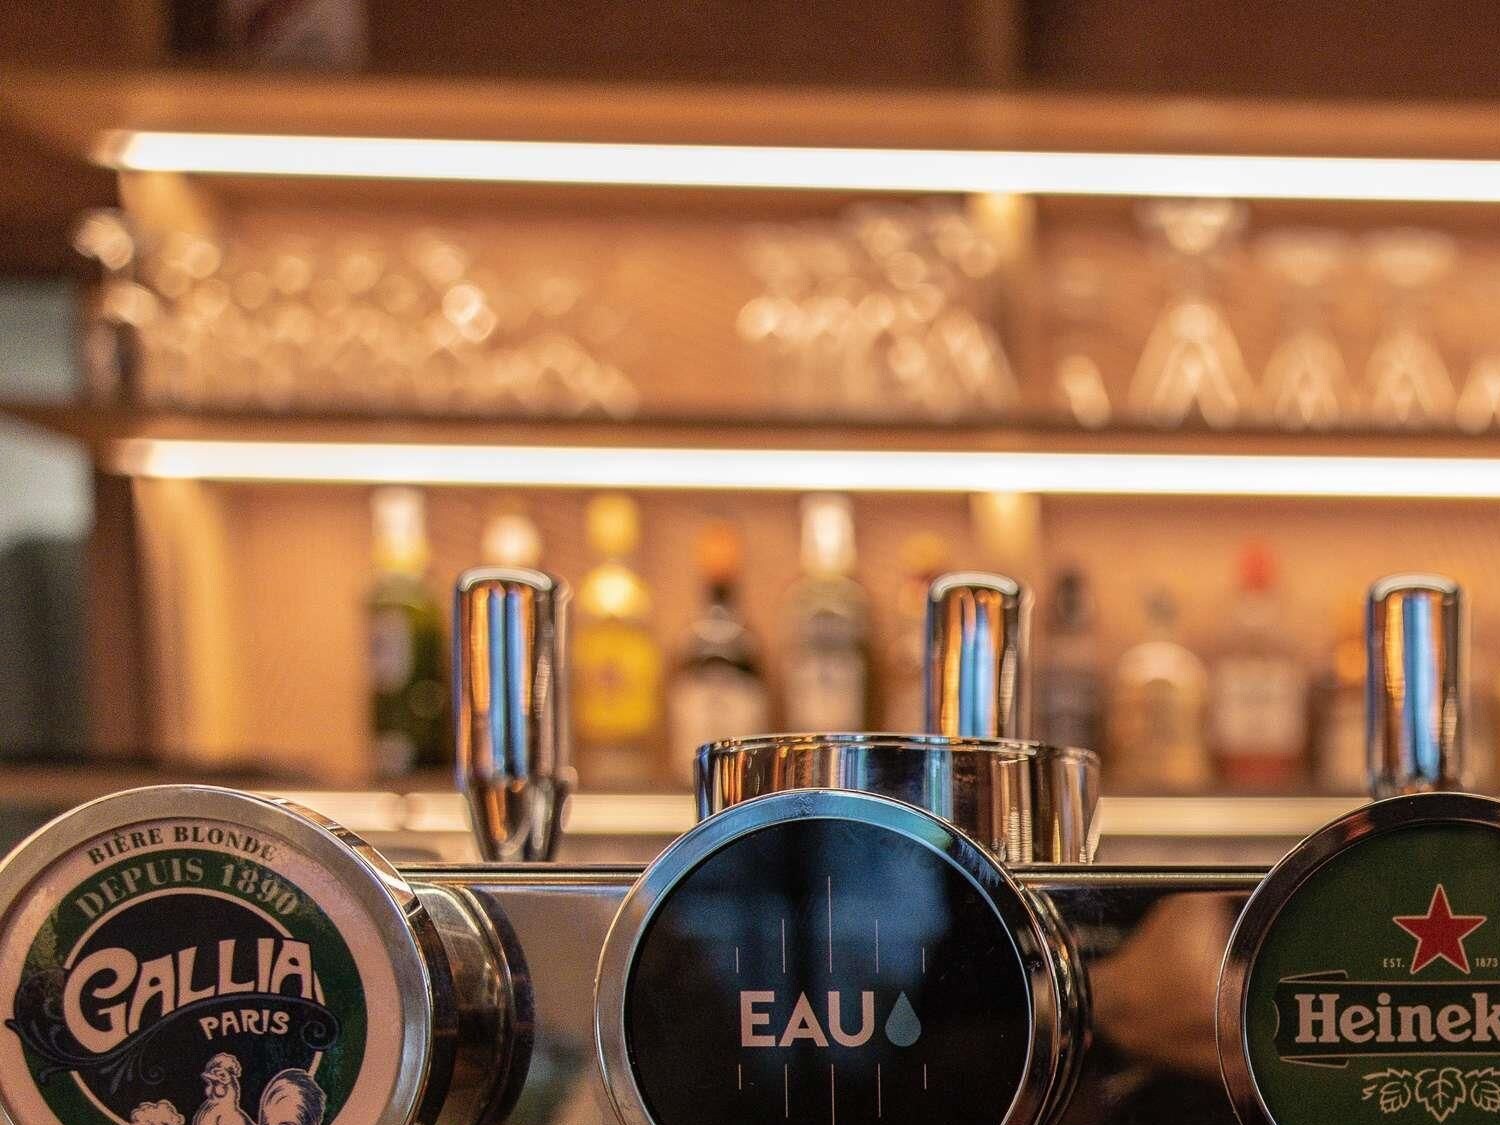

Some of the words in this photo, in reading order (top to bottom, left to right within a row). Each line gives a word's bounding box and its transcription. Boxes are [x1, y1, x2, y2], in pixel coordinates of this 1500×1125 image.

[87, 826, 164, 866] BIÈRE
[172, 825, 278, 862] BLONDE
[75, 857, 205, 920] DEPUIS
[220, 863, 302, 916] 1890
[1382, 957, 1405, 969] EST.
[1474, 957, 1499, 968] 1873
[63, 938, 325, 1054] GALLIA
[740, 990, 875, 1048] EAU
[199, 1009, 290, 1040] PARIS
